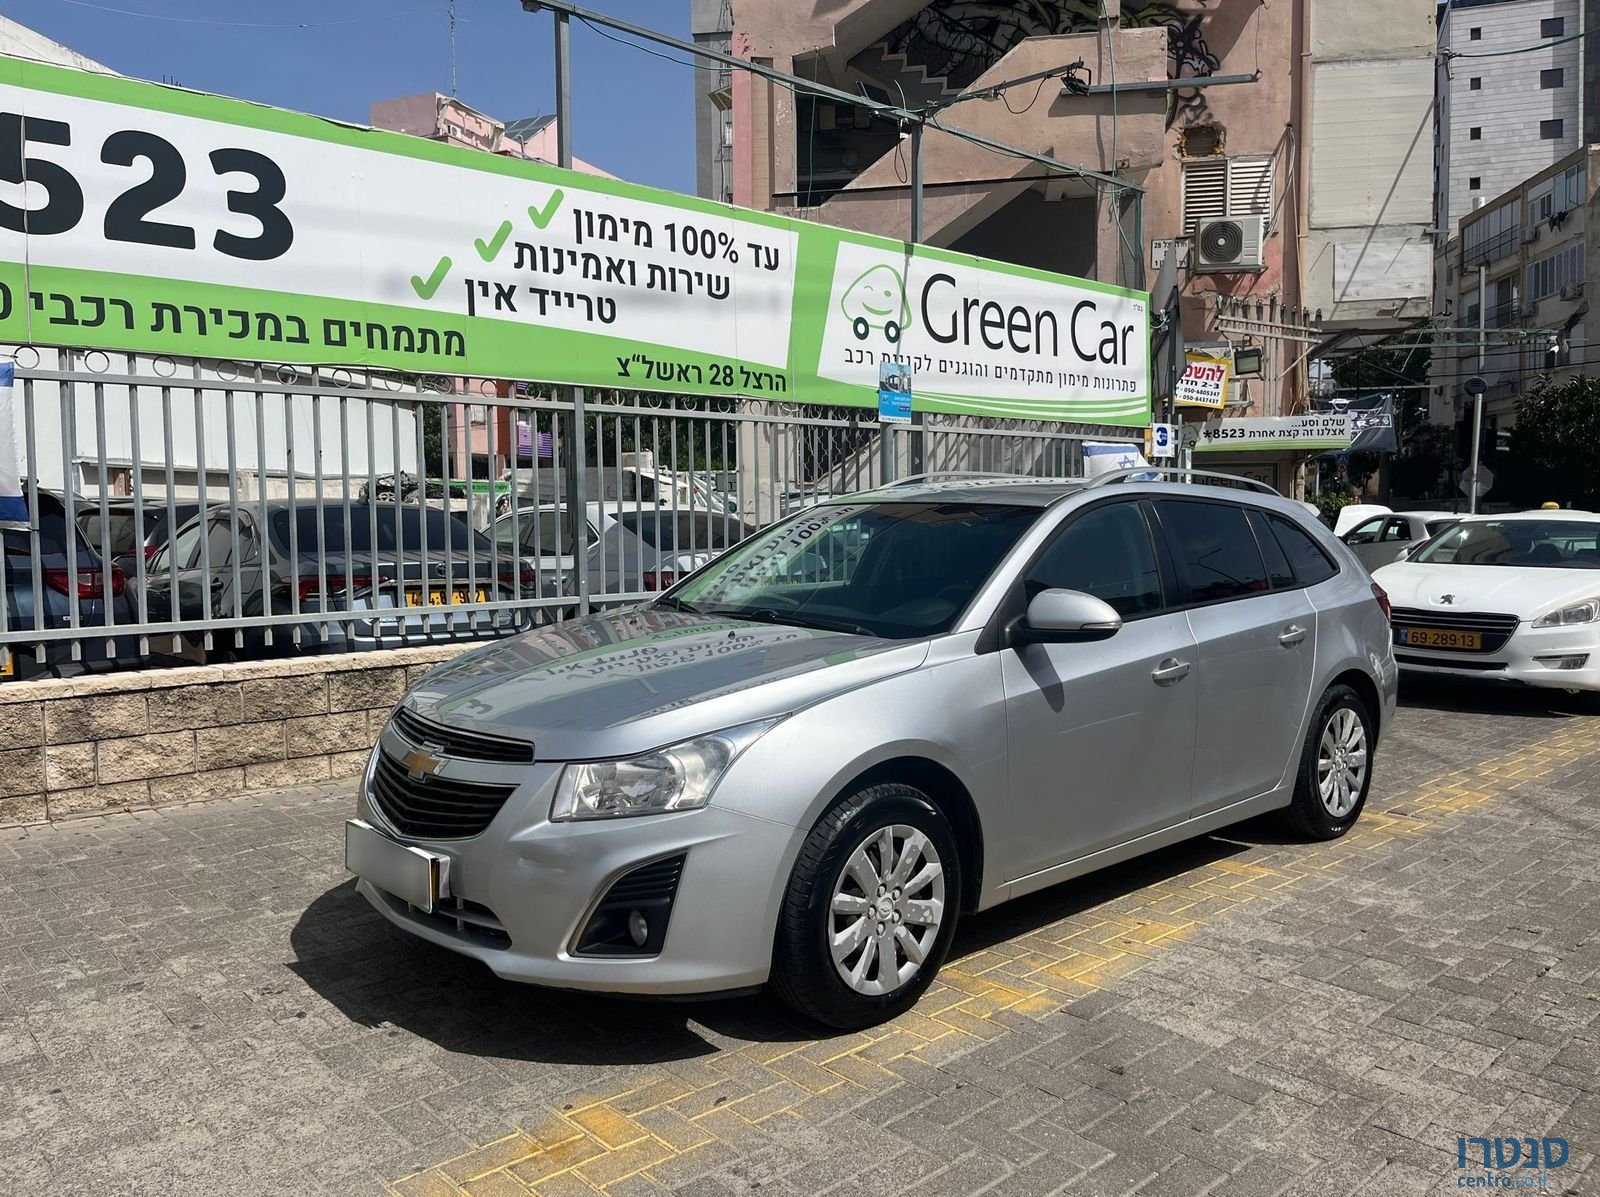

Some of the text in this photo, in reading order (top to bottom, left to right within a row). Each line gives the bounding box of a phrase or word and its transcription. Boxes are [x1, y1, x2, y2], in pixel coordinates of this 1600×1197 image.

[573, 209, 779, 270] עד 100% מימון
[514, 241, 730, 299] שירות ואמינות
[30, 292, 134, 329] רכבי
[465, 279, 616, 324] טרייד אין
[151, 302, 309, 344] במכירת
[921, 273, 1134, 366] Green Car
[323, 319, 465, 356] מתמחים
[845, 348, 874, 365] רכב
[709, 363, 734, 387] 28
[939, 359, 988, 378] והוגנים
[995, 366, 1053, 386] מתקדמים
[740, 366, 786, 392] הרצל
[1058, 372, 1089, 388] מימון
[1093, 376, 1136, 392] פתרונות
[1316, 427, 1345, 436] אצלנו
[1322, 417, 1345, 426] שלם
[1249, 430, 1276, 438] אחרת
[1279, 429, 1299, 439] קצת
[1303, 428, 1314, 436] זה
